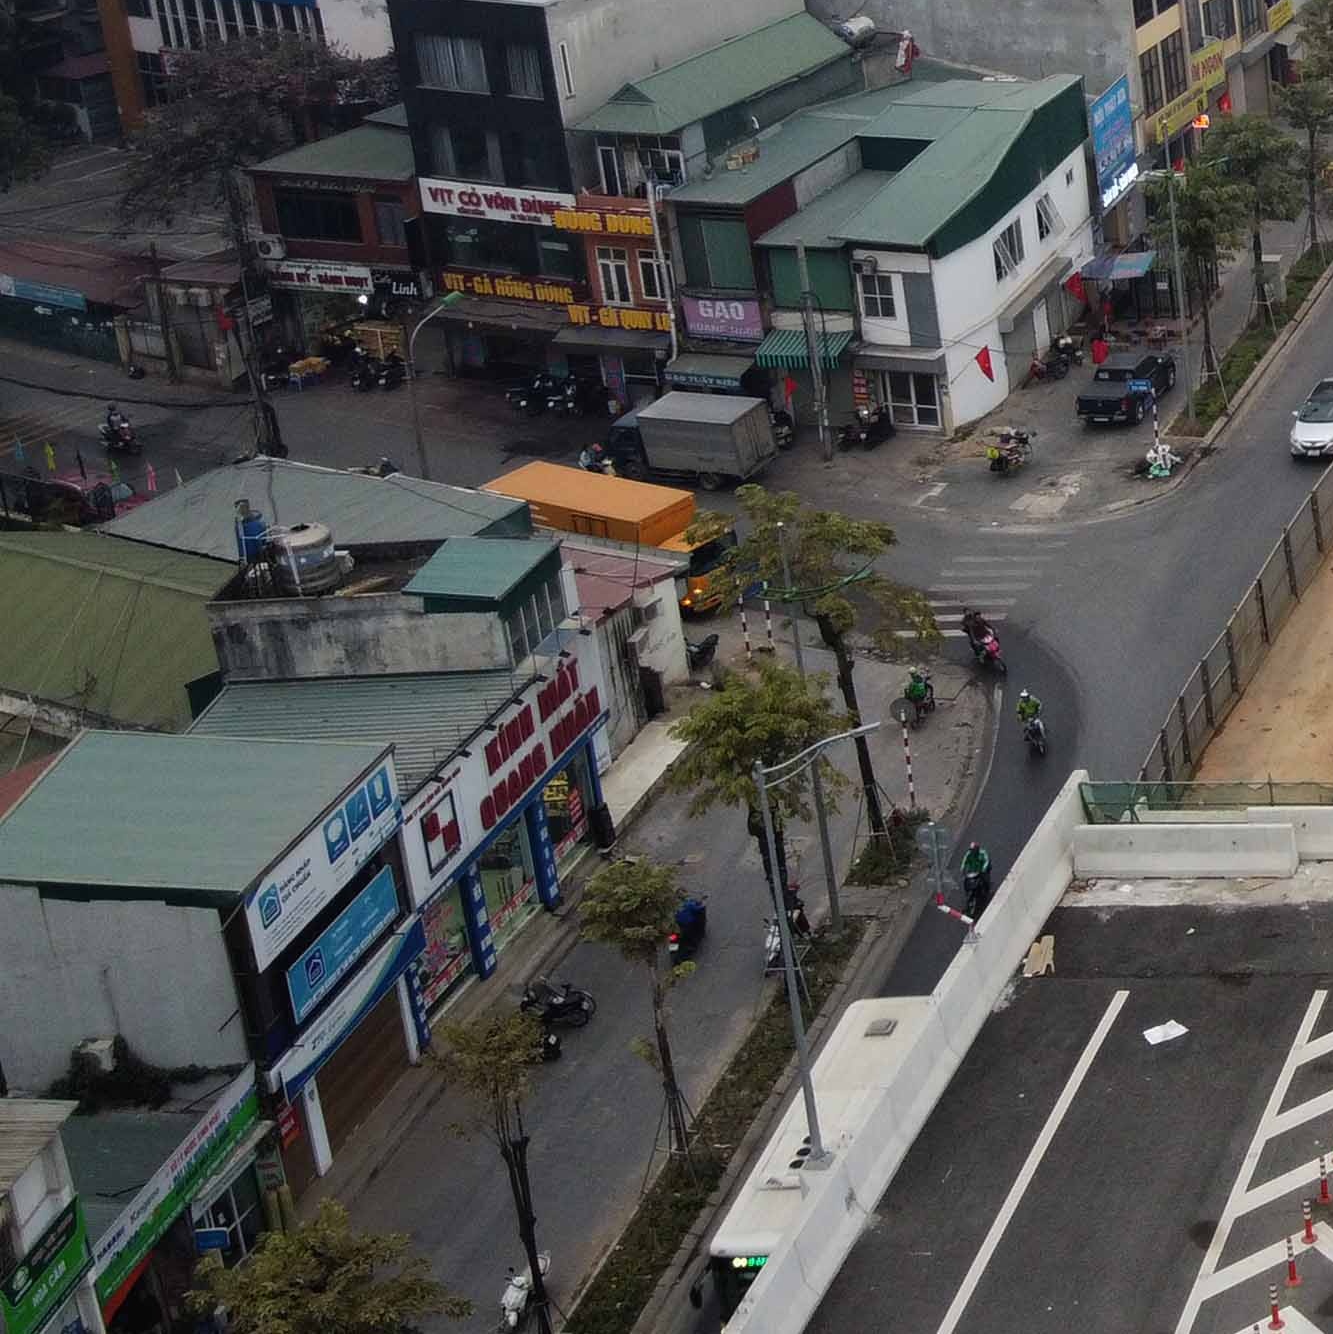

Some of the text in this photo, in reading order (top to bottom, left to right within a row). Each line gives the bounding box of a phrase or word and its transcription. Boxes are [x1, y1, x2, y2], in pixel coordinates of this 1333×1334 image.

[428, 186, 454, 206] VỊT
[457, 186, 481, 206] CỎ
[482, 191, 518, 211] VÂN
[392, 281, 418, 296] Linh
[443, 273, 464, 291] VỊT
[472, 274, 494, 295] GÀ
[568, 305, 591, 325] VỊT
[484, 704, 535, 776] KÍNH
[479, 742, 548, 831] QUANG
